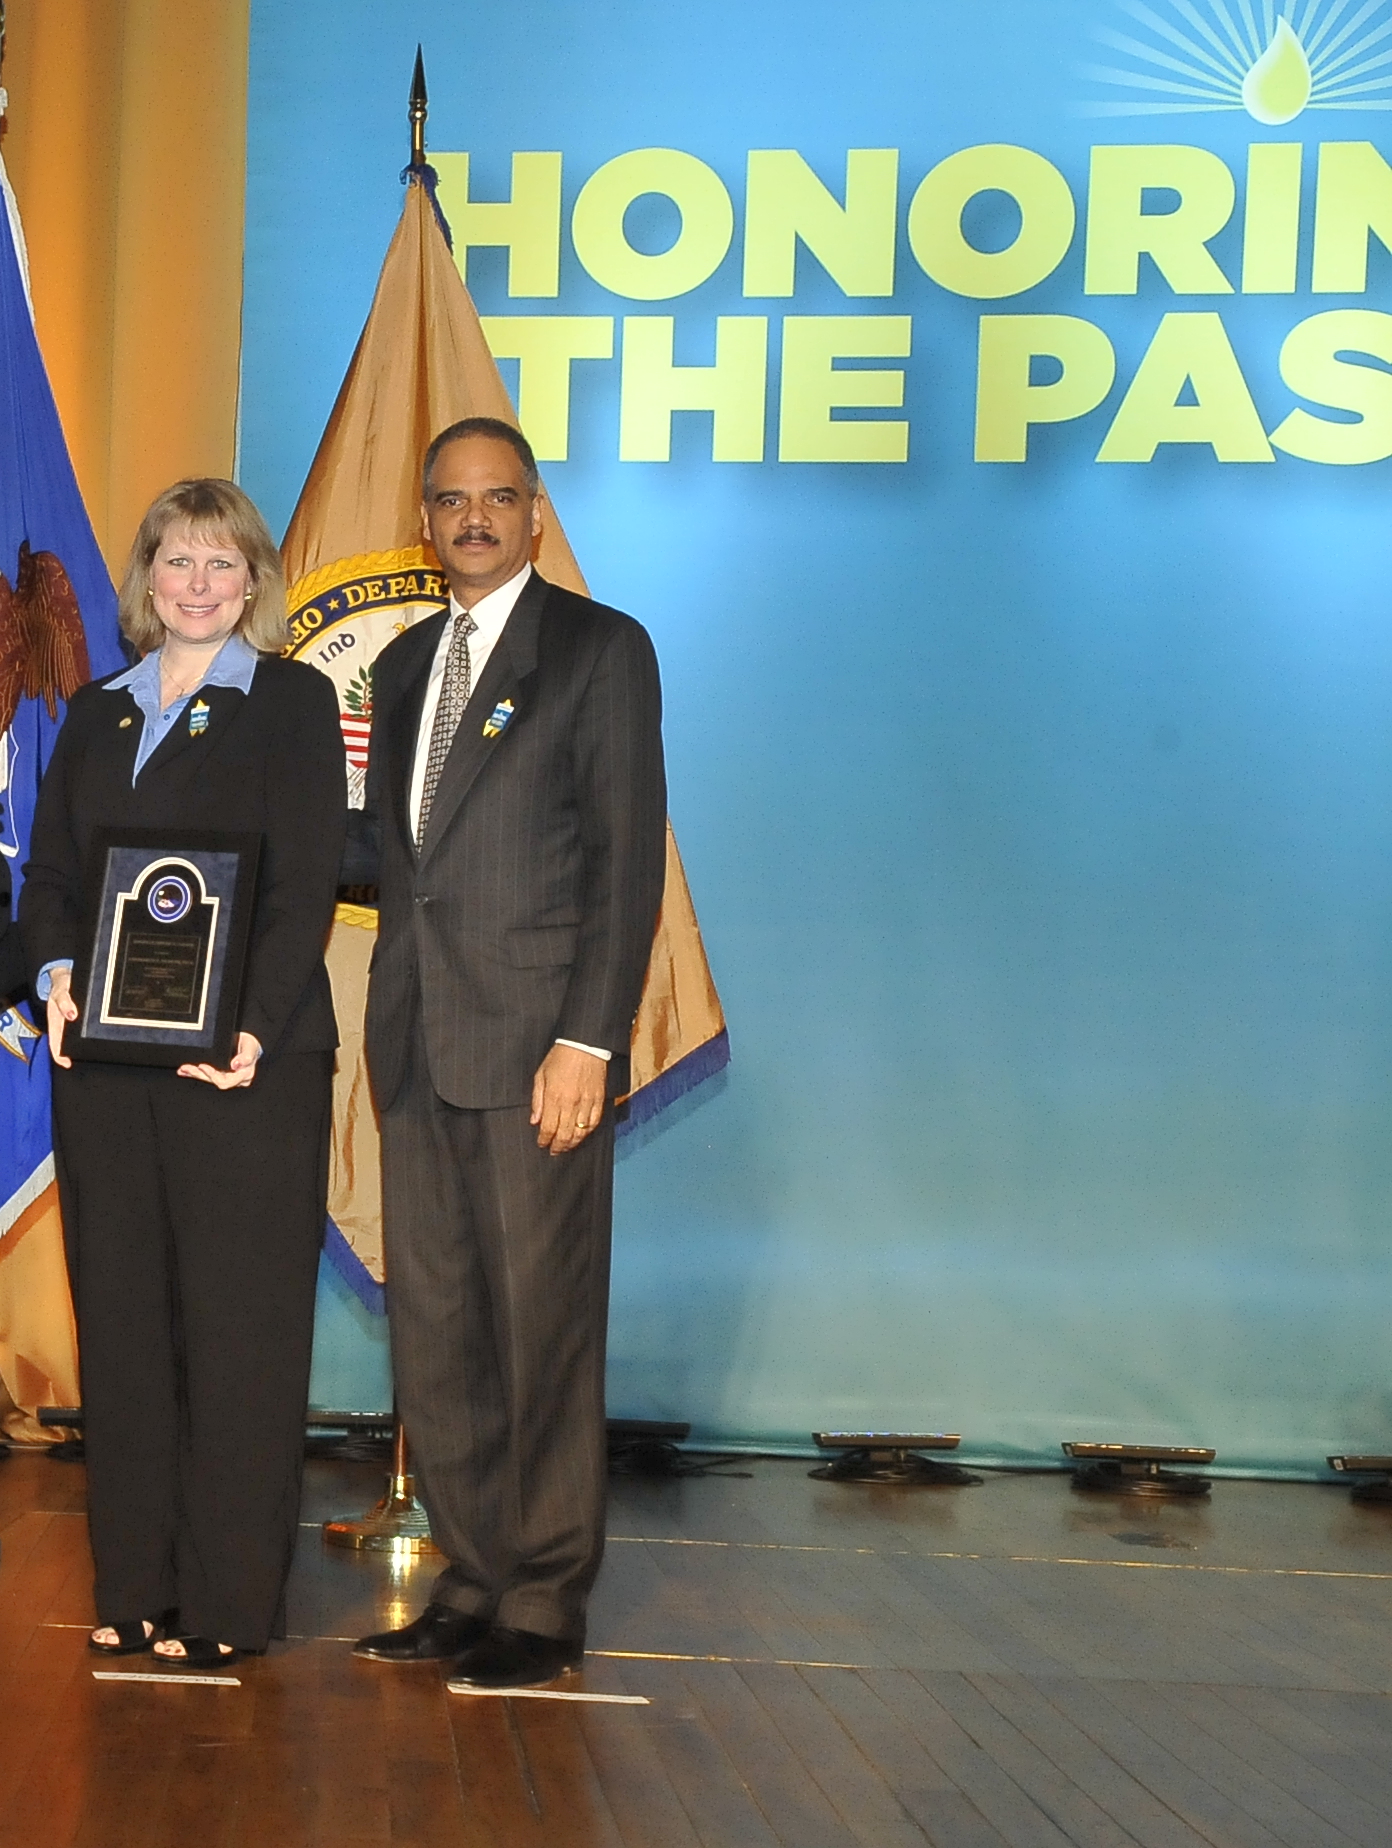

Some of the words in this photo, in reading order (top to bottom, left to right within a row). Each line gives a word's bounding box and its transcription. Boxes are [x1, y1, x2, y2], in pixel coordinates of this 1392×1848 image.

[480, 314, 912, 464] THE
[974, 308, 1392, 466] PAS
[342, 574, 450, 608] DEPAR
